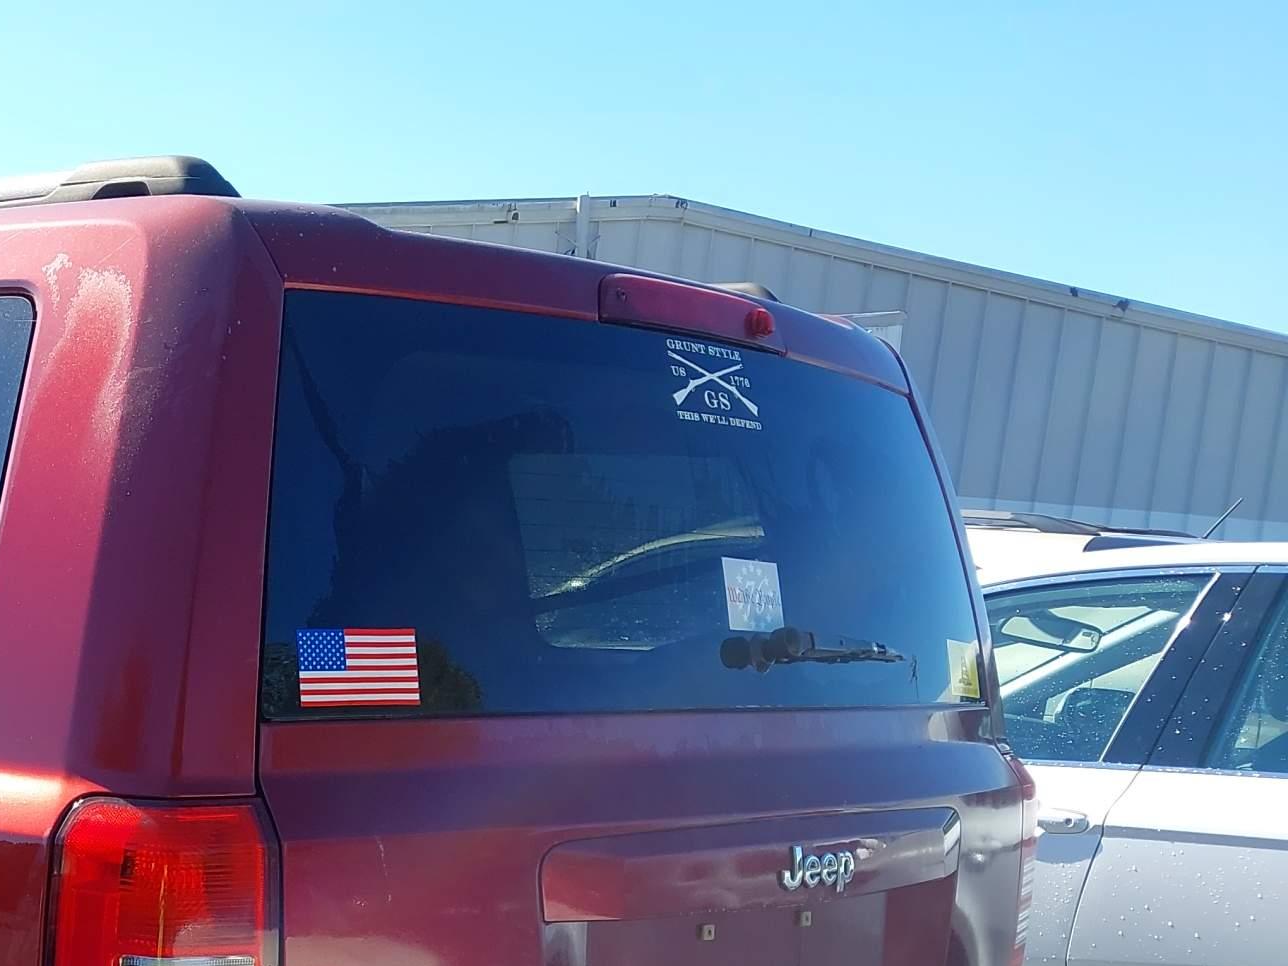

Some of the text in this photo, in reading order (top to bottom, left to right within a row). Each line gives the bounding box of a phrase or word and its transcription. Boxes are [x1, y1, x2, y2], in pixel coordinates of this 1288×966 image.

[666, 338, 742, 361] GRUNT STYLE
[670, 365, 687, 377] US
[704, 390, 731, 411] GS
[677, 410, 762, 430] THIS WE'LL DEFEND
[781, 844, 855, 893] Jeep
